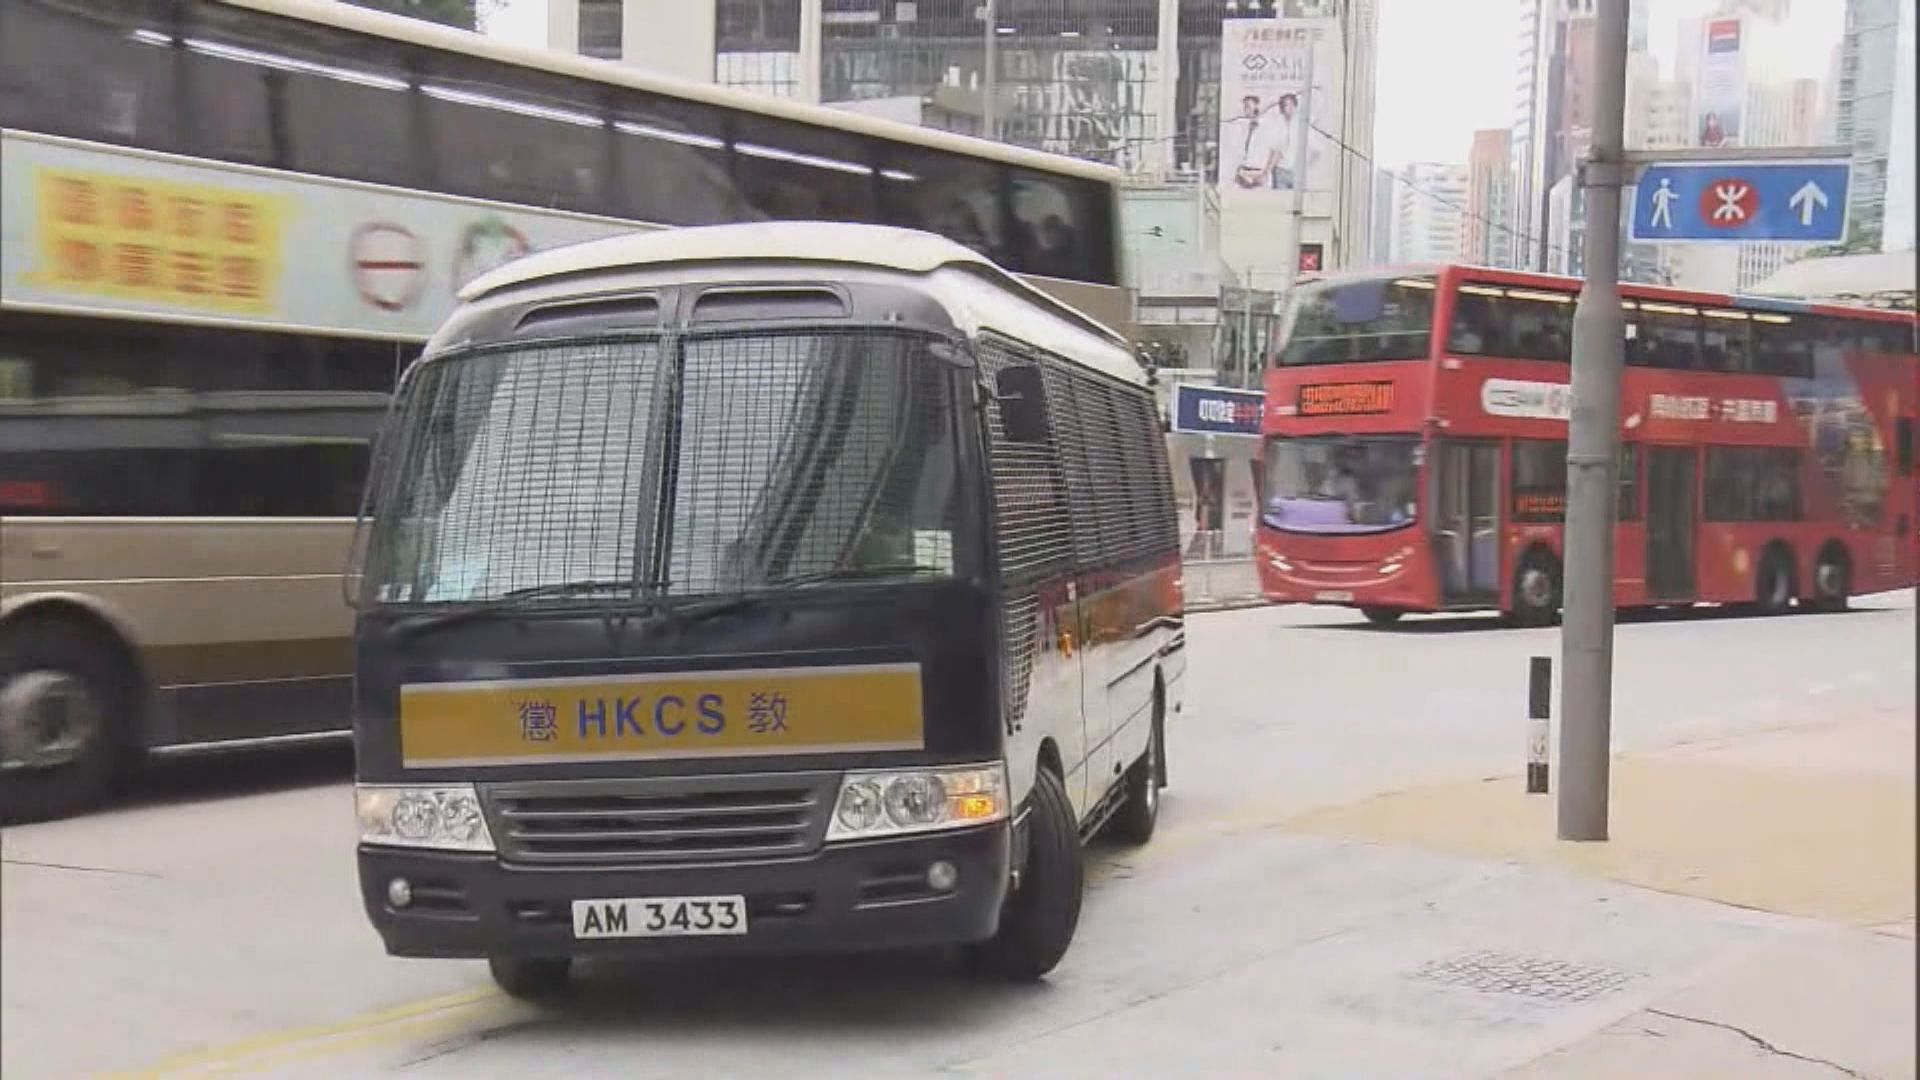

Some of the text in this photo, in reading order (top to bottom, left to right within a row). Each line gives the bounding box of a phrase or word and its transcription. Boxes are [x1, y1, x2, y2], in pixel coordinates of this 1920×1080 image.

[578, 694, 726, 738] HKCS
[583, 902, 738, 934] AM 3433
